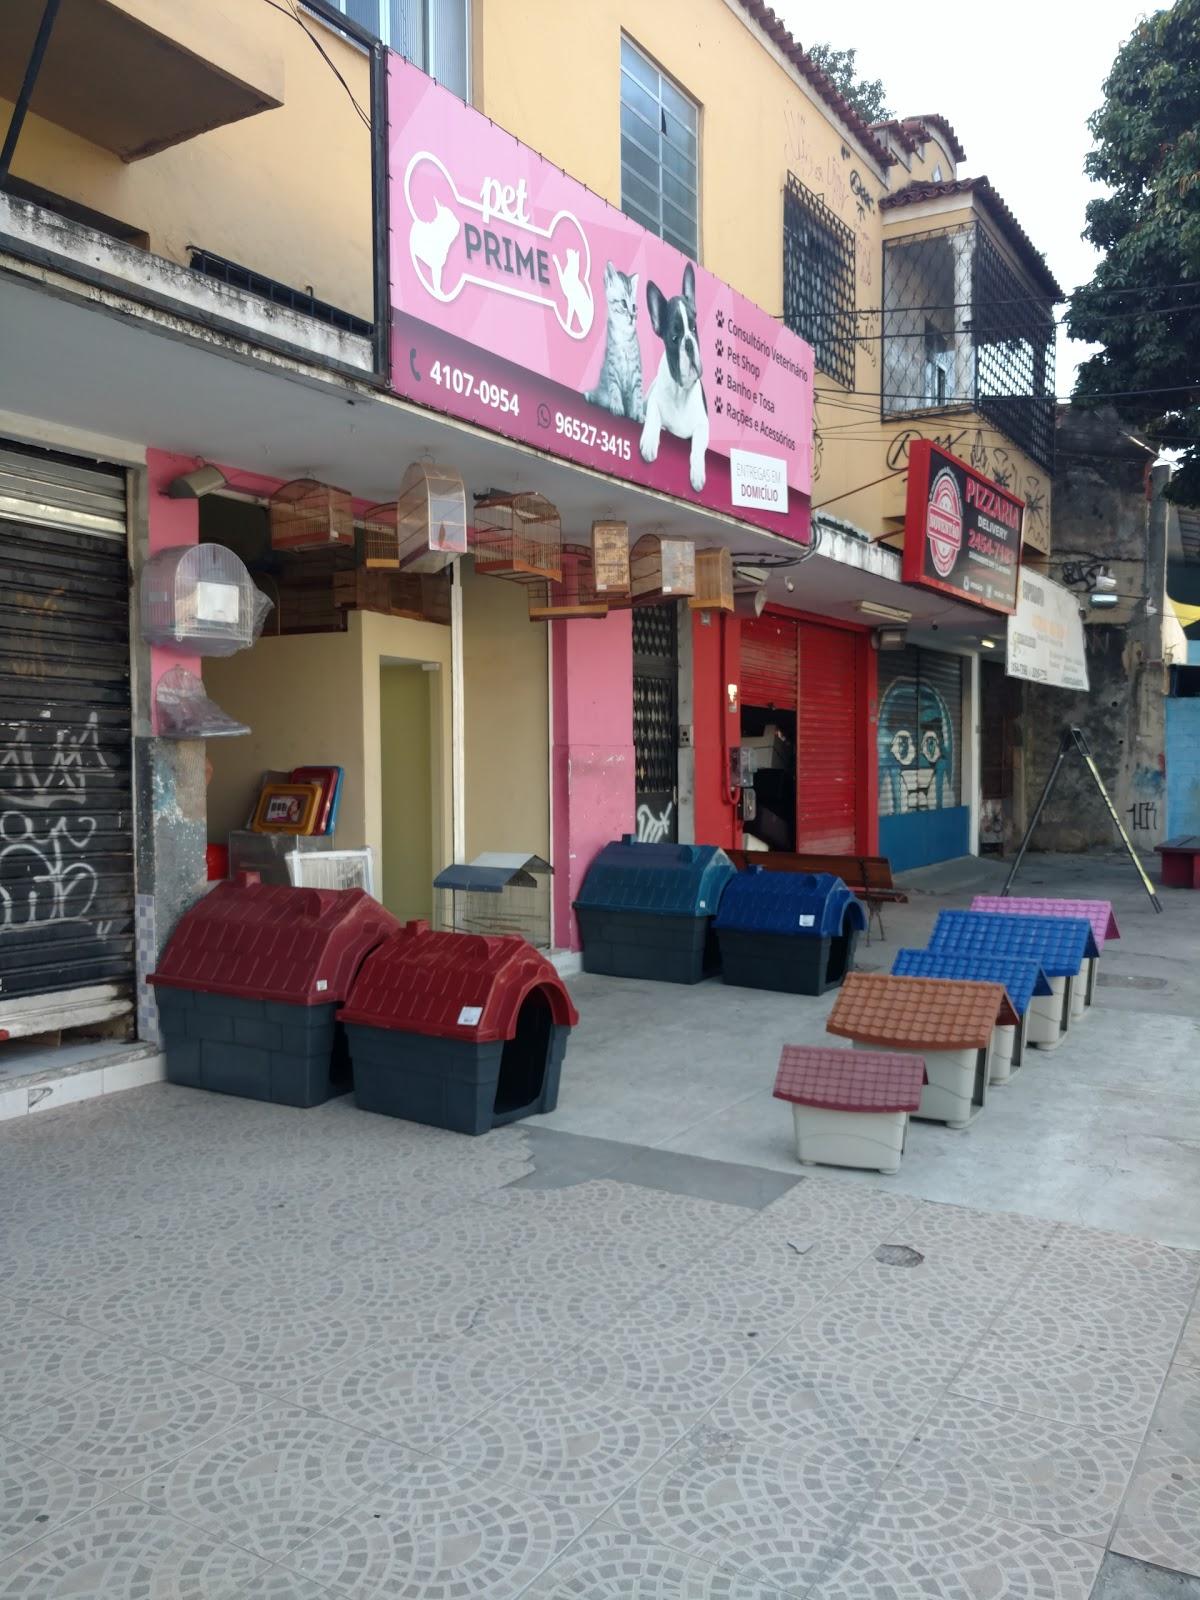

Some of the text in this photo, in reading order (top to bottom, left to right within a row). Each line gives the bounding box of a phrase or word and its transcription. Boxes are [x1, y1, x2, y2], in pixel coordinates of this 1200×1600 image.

[480, 176, 530, 224] pet
[464, 222, 550, 285] PRIME
[727, 319, 808, 383] Consultório Veterinário
[727, 346, 760, 381] Pet Shop
[430, 360, 520, 416] 4107-0954
[727, 374, 775, 414] Banho e Tosa
[555, 411, 631, 461] 96527-3415
[726, 402, 796, 451] Rações e Acessórios
[736, 463, 781, 484] ENTREGAS EM
[741, 484, 779, 502] DOMICÍLIO
[965, 476, 1020, 531] PIZZARIA
[977, 514, 1008, 541] DELIVERY
